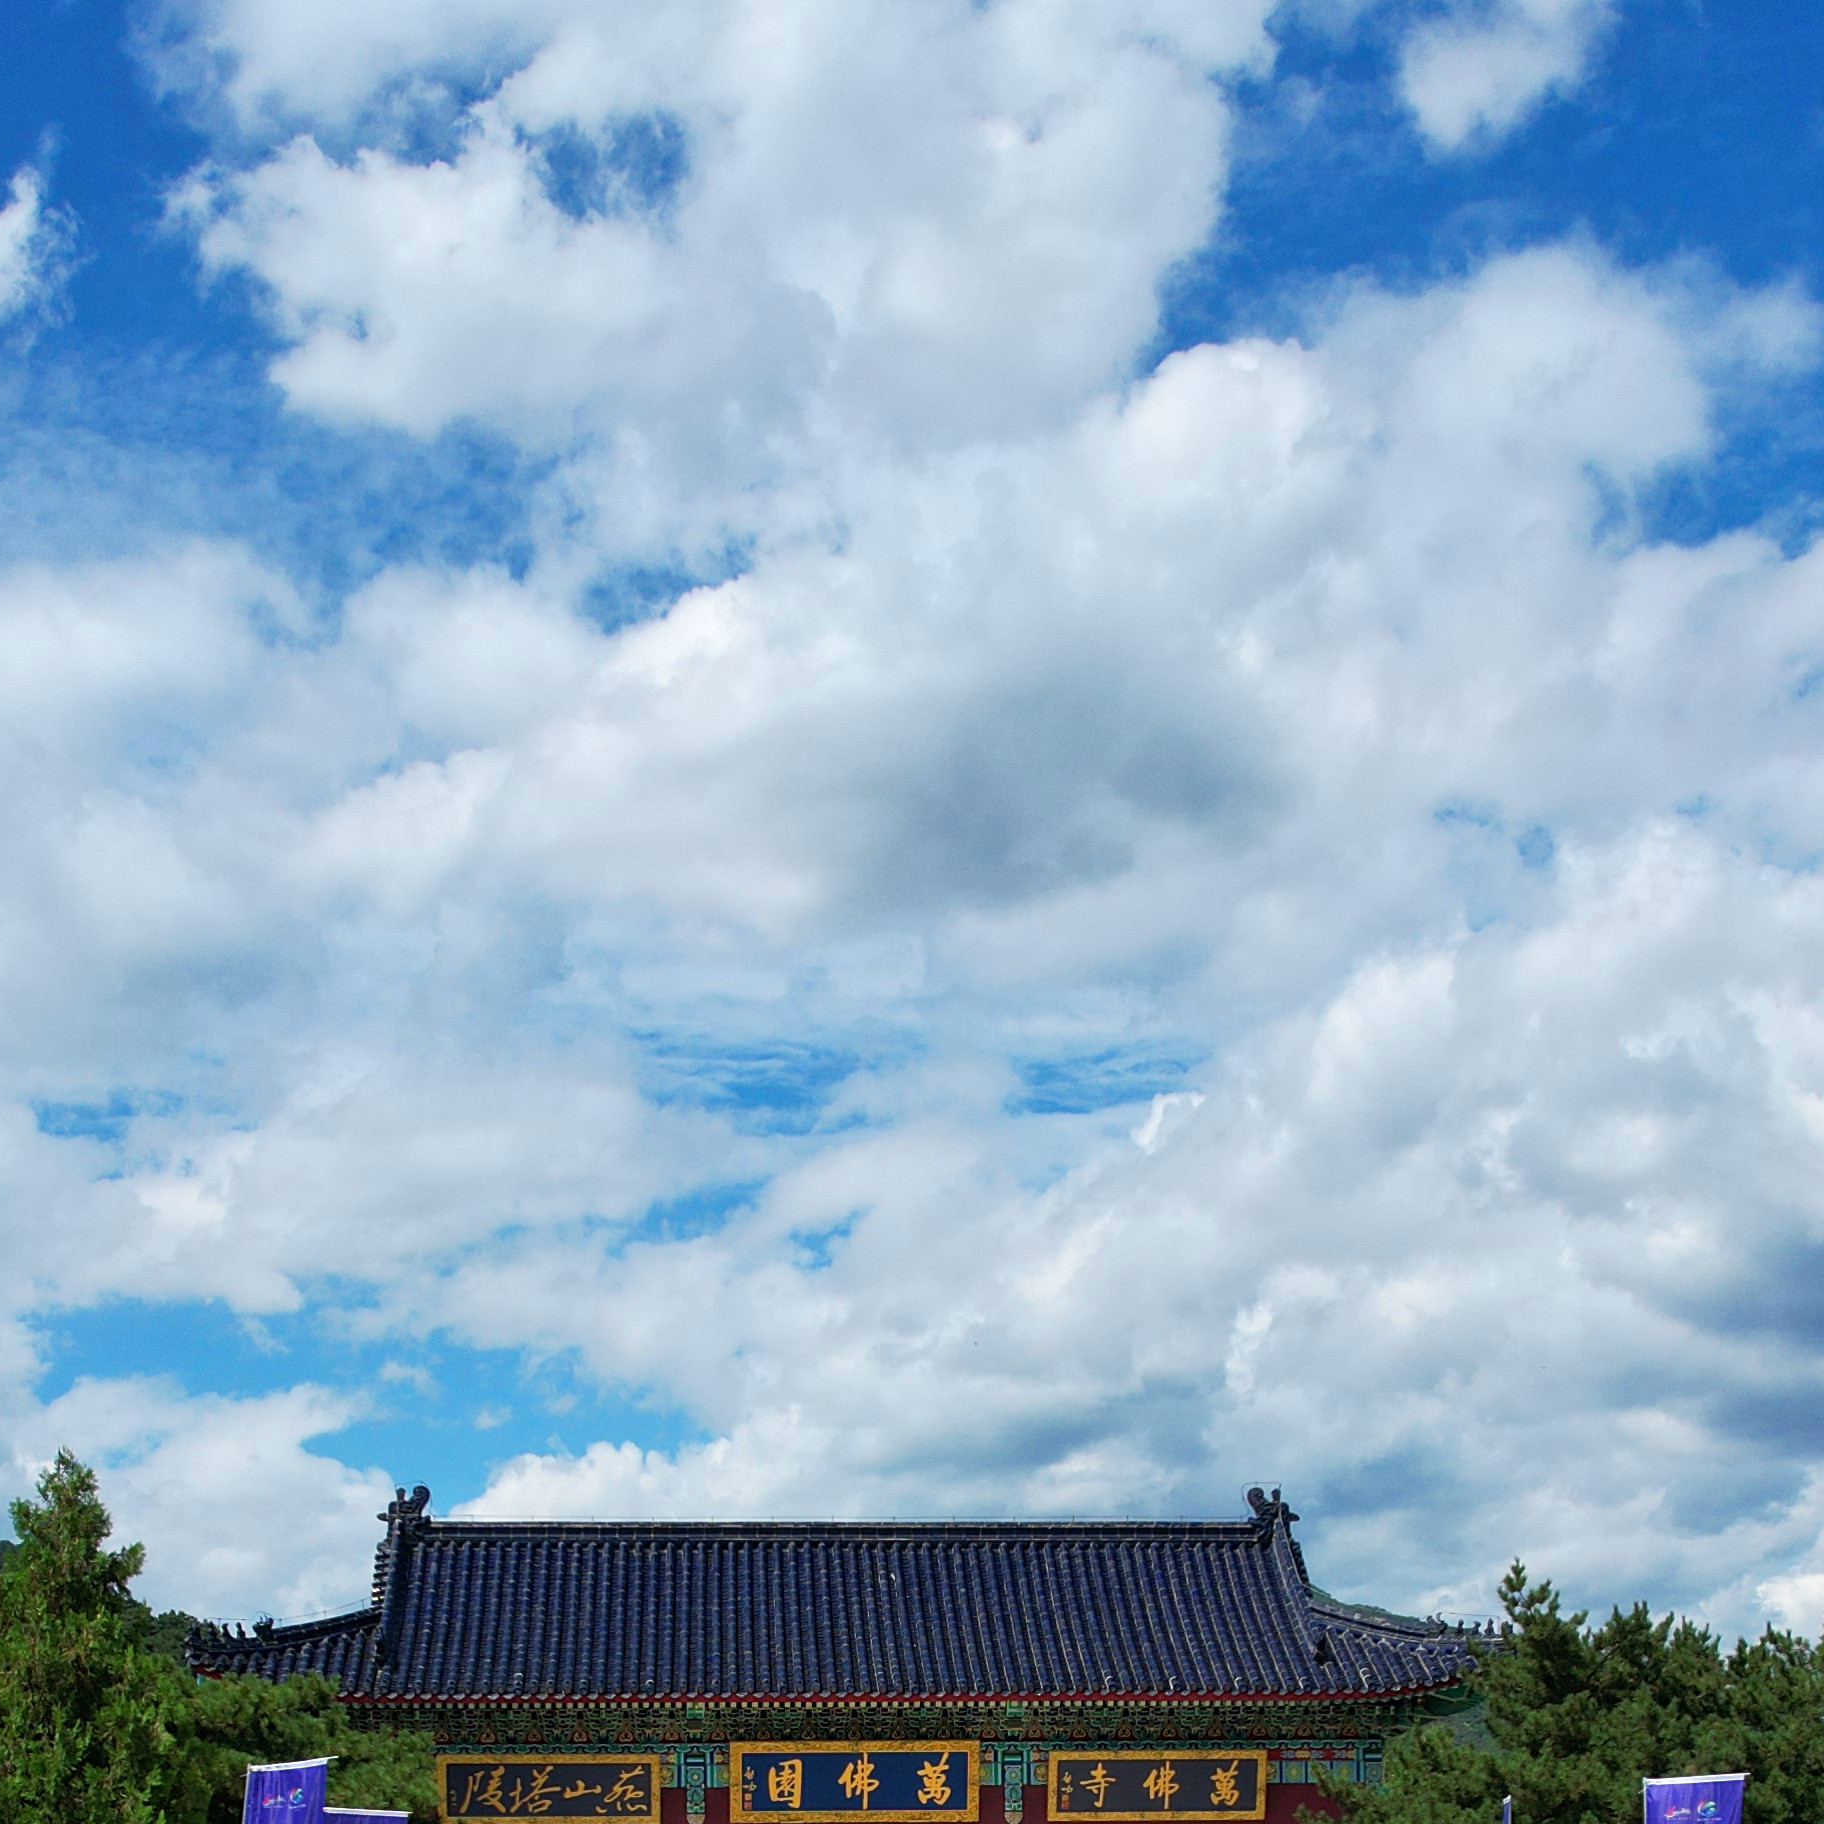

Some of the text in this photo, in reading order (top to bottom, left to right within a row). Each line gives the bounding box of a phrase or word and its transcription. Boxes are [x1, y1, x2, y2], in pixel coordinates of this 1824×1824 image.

[767, 1752, 952, 1811] 萬佛園
[1079, 1759, 1242, 1810] 萬佛寺
